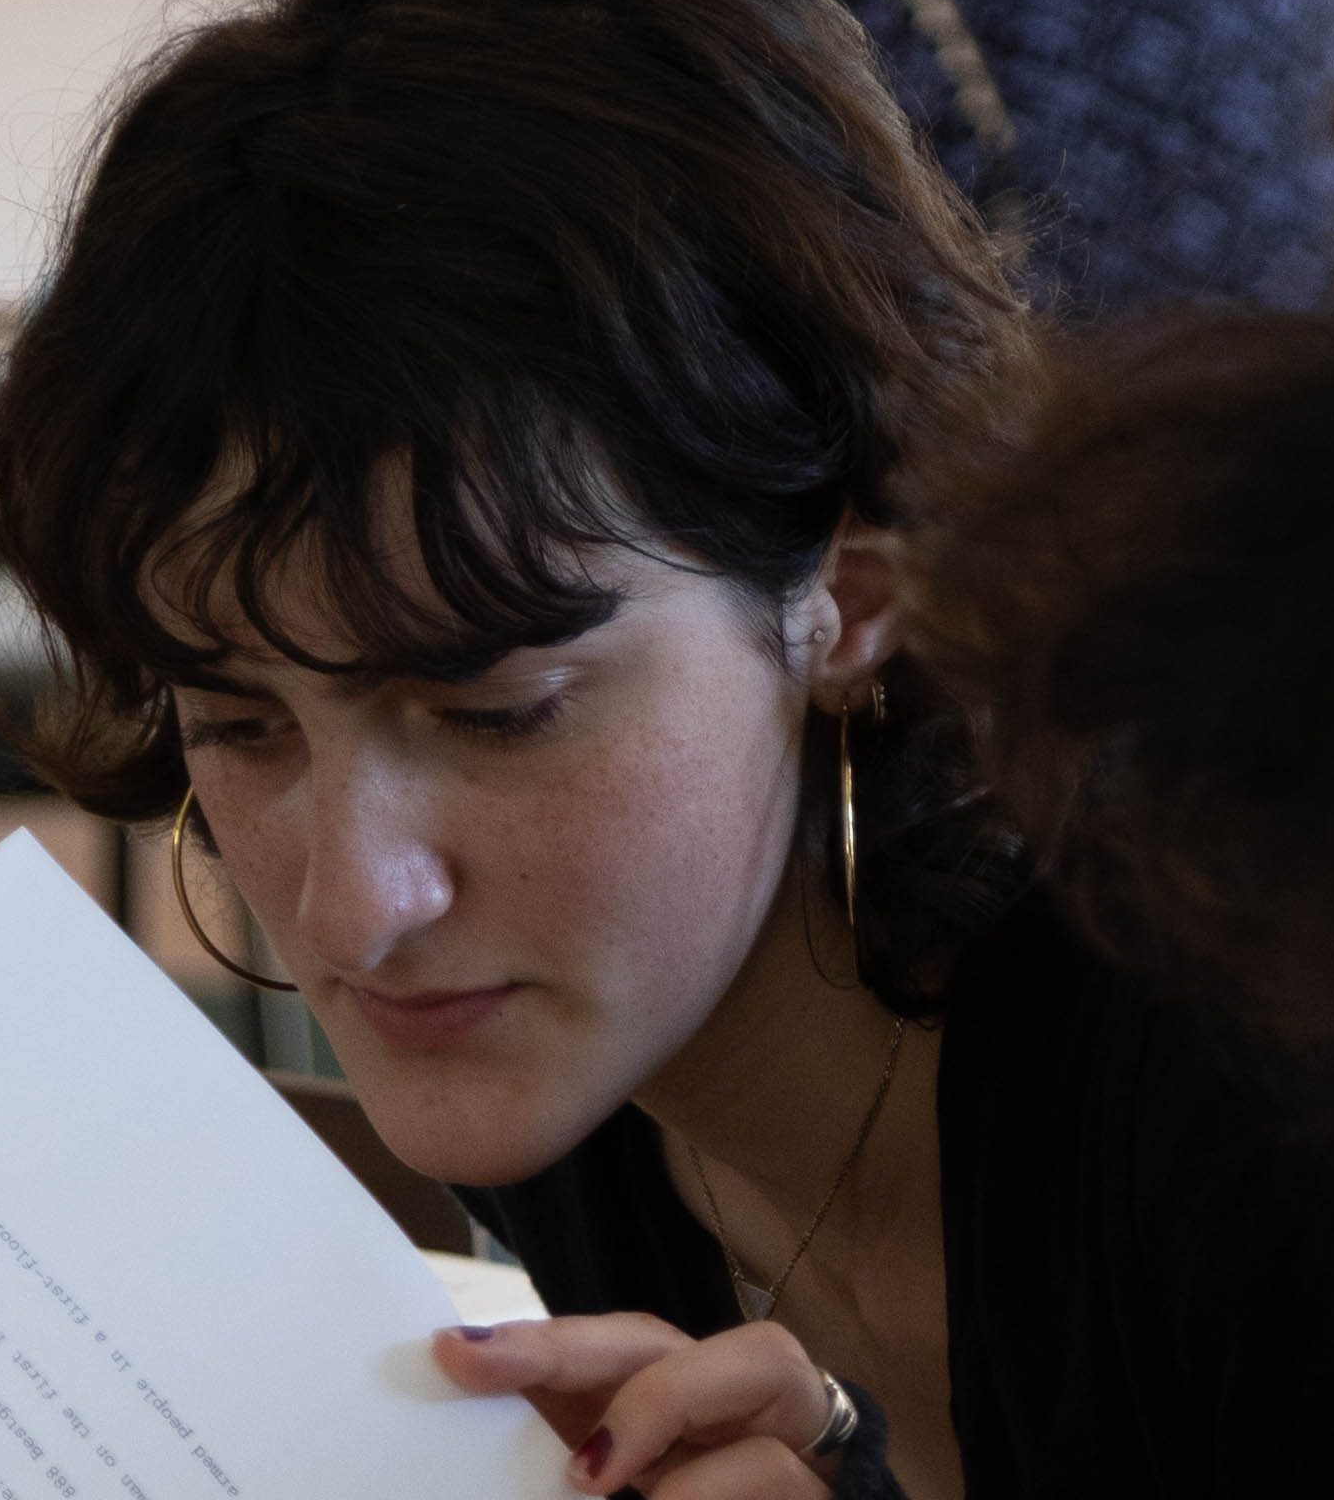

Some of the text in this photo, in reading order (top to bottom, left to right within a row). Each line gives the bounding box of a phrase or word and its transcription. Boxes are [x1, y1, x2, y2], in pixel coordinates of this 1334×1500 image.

[93, 1330, 107, 1342] a
[11, 1350, 58, 1400] first
[110, 1349, 132, 1372] in
[61, 1406, 90, 1439] the
[135, 1378, 194, 1439] people
[95, 1444, 116, 1467] on
[190, 1444, 239, 1496] armed
[45, 1465, 76, 1498] 888
